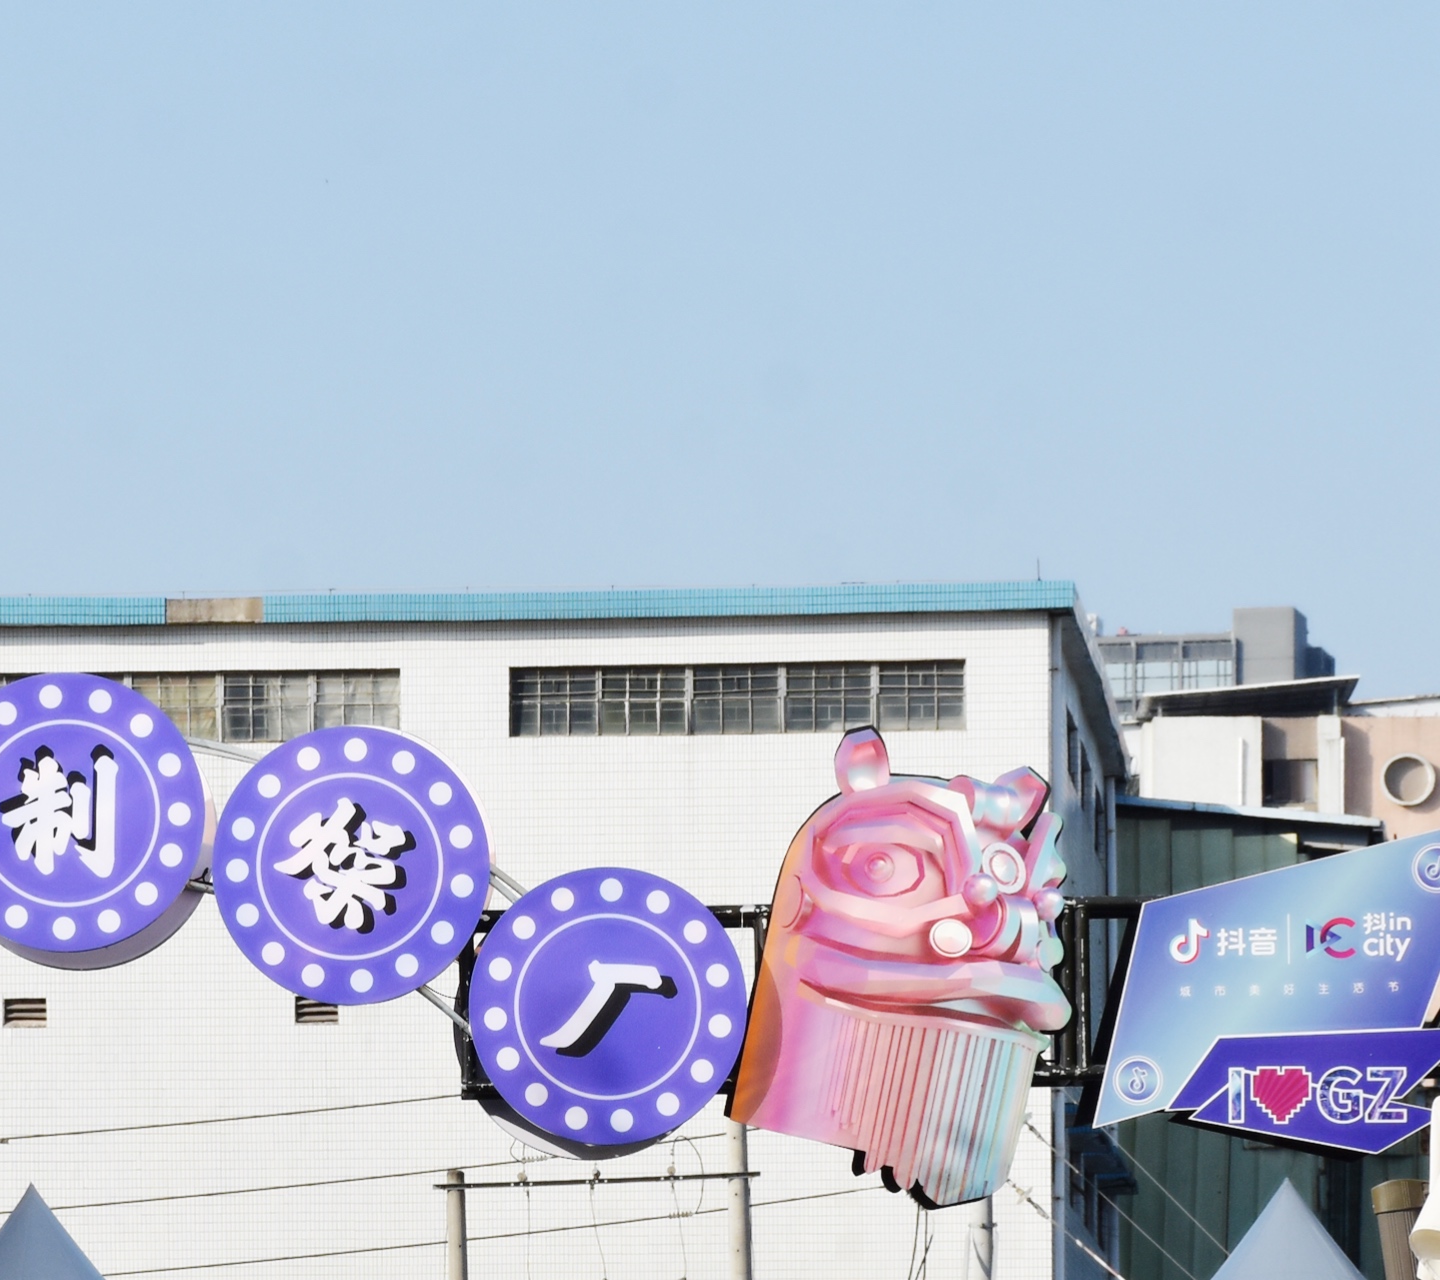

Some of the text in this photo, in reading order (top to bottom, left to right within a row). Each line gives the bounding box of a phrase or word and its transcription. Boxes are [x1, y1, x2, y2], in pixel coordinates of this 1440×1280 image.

[1363, 912, 1412, 934] 抖in
[1216, 927, 1278, 956] 抖音
[1363, 932, 1412, 962] city
[1179, 982, 1400, 998] 城市美好生活节
[1316, 1066, 1408, 1125] GZ
